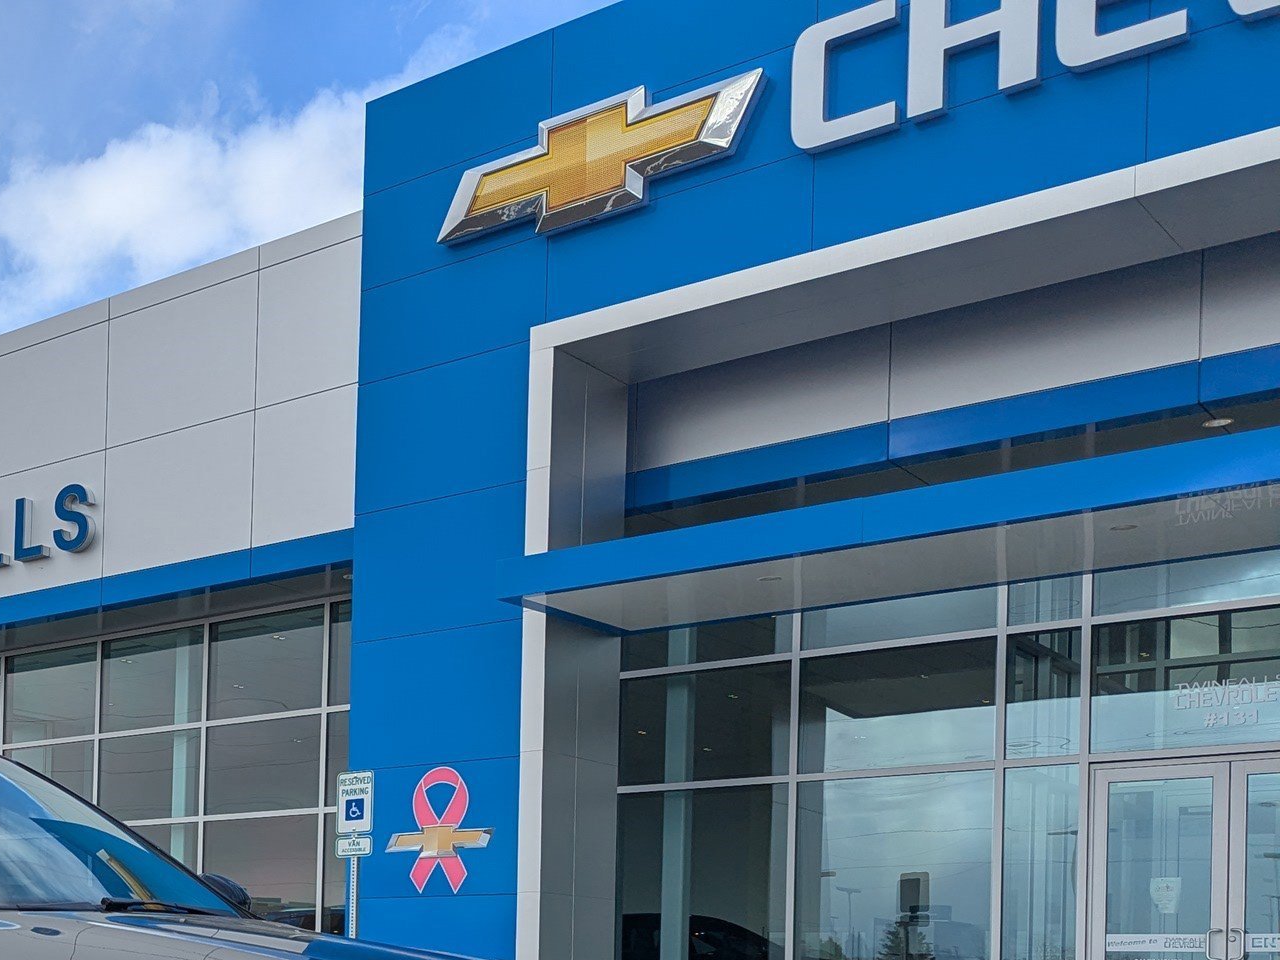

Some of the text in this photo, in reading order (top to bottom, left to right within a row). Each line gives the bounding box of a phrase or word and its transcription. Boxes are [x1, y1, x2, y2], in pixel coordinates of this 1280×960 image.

[339, 775, 372, 786] RESERVED
[341, 786, 369, 797] PARKING
[1251, 937, 1280, 949] EN
